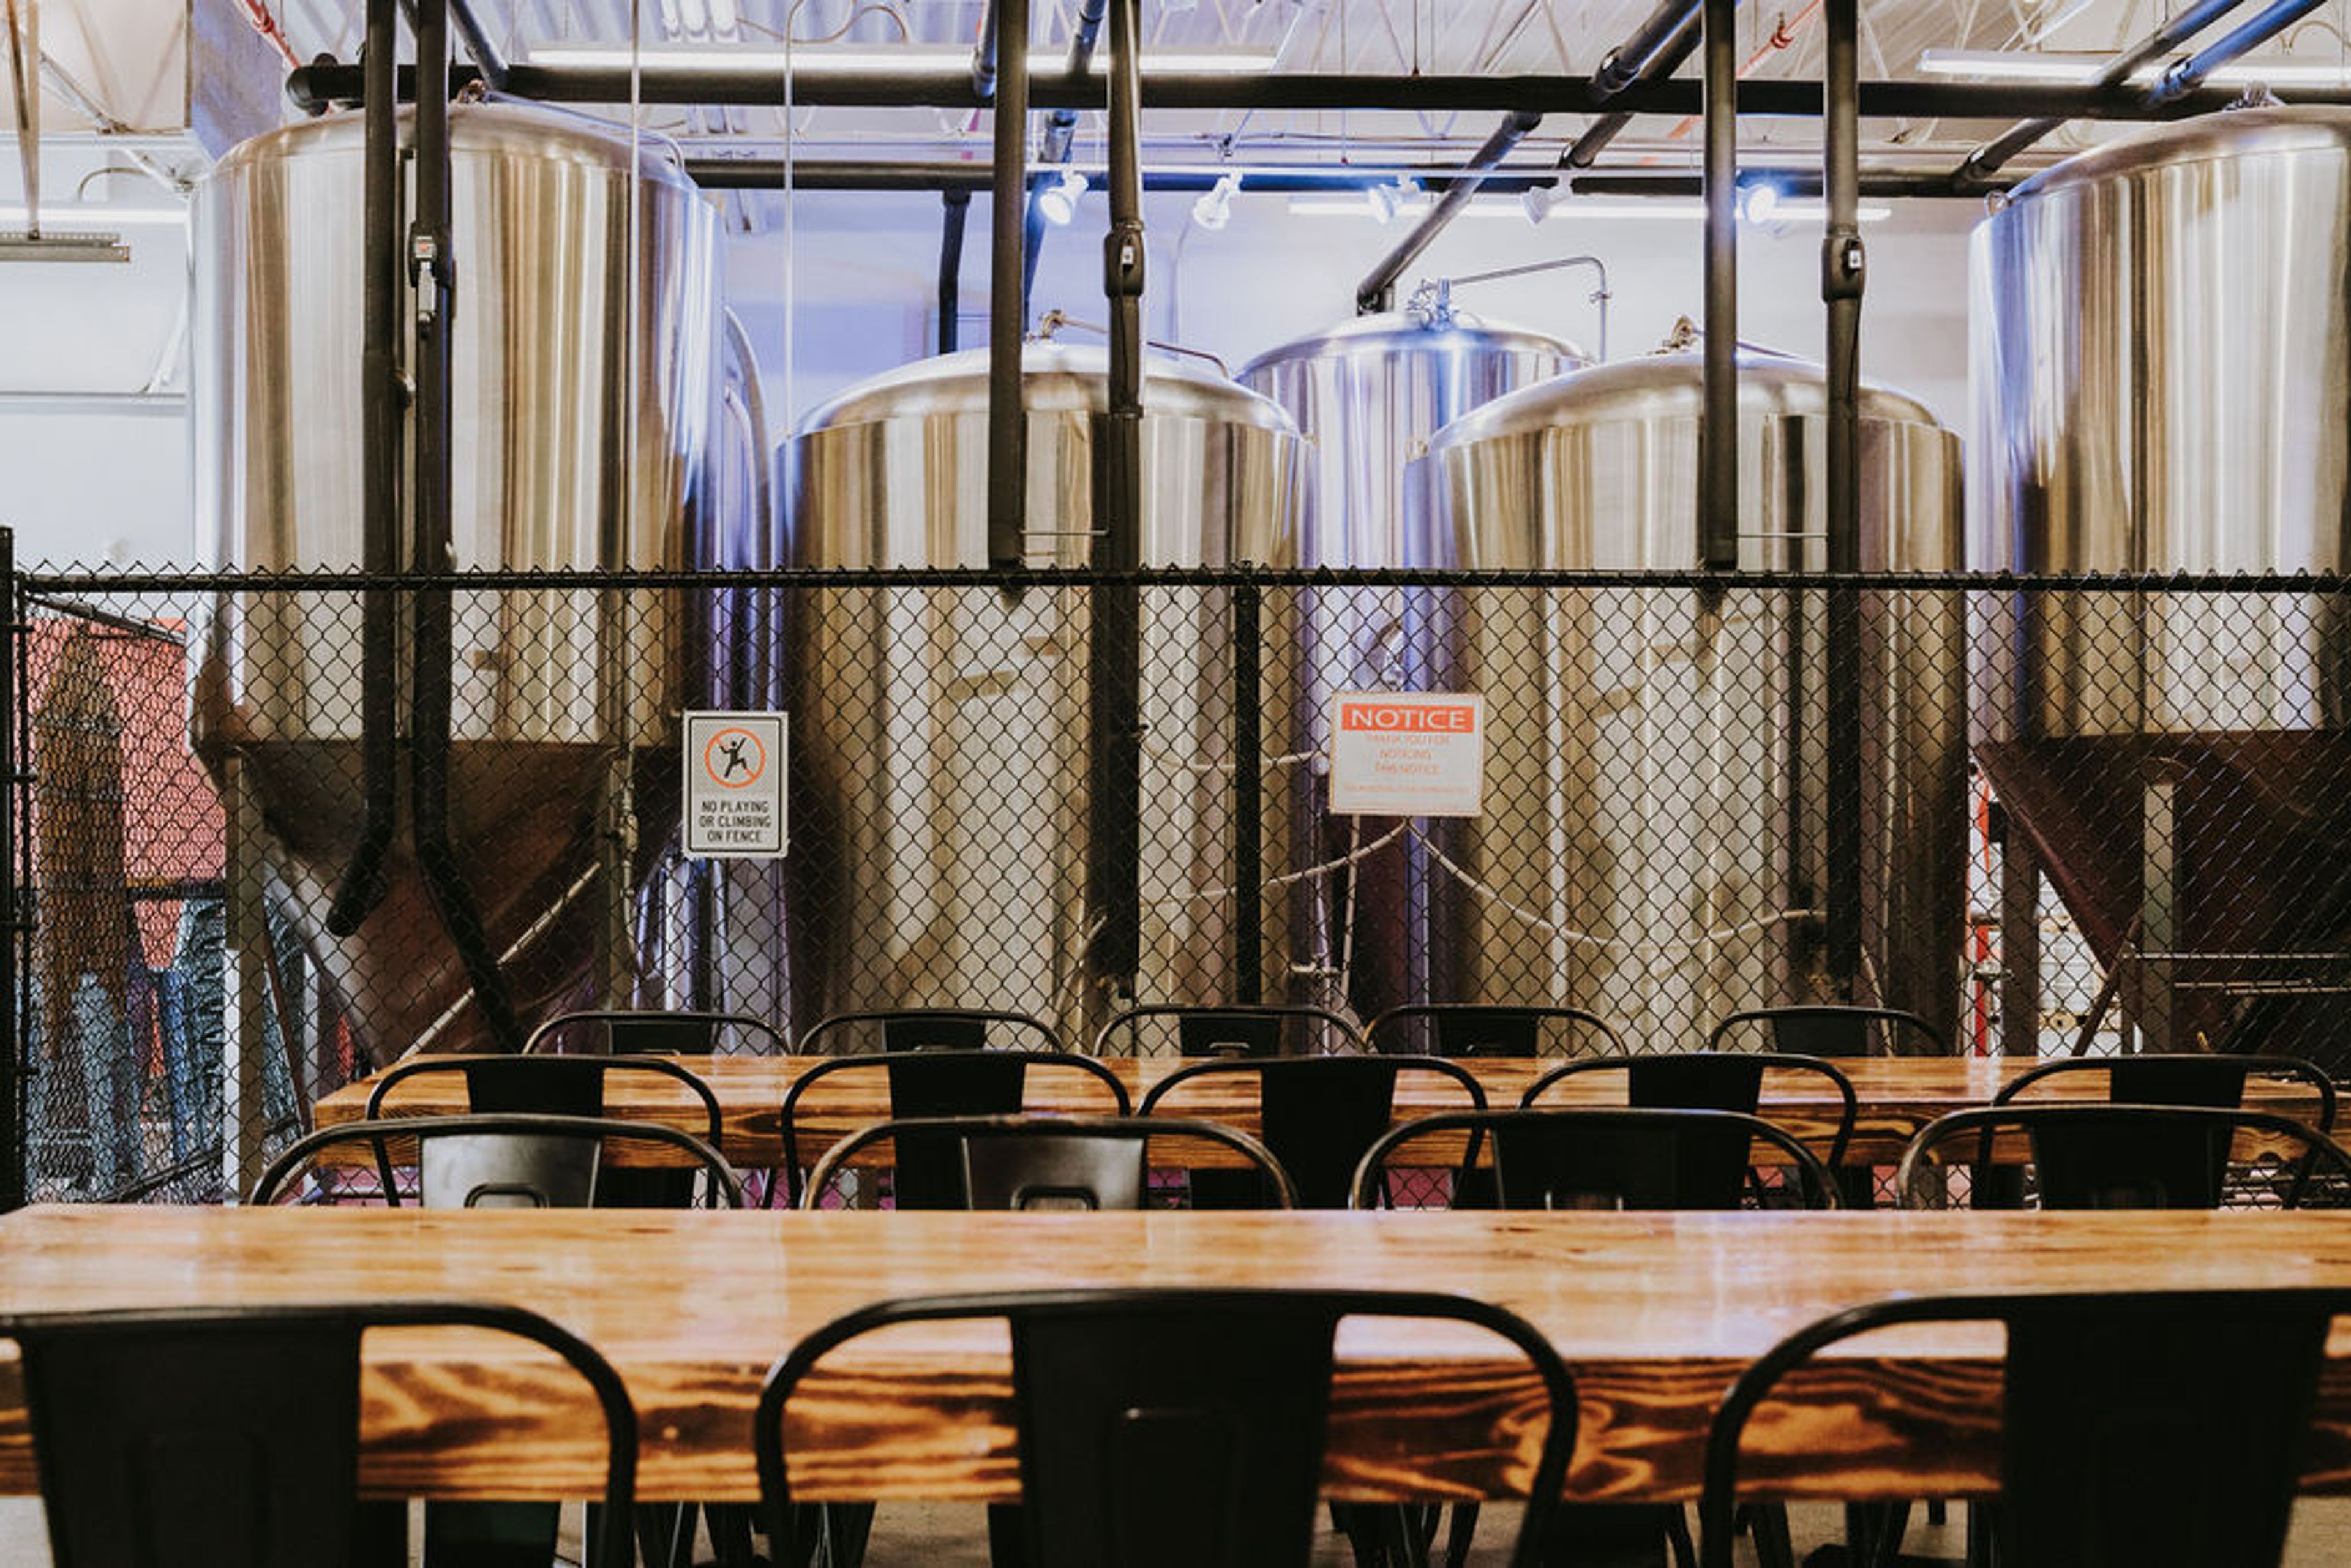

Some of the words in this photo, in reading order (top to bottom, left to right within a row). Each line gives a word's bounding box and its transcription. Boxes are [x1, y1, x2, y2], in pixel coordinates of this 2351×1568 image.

[1352, 708, 1465, 729] NOTICE
[1365, 735, 1400, 743] THANK
[1404, 735, 1427, 744] YOU
[1428, 735, 1450, 744] FOR
[1379, 749, 1431, 759] NOTICING
[1375, 762, 1397, 773] THIS
[1400, 763, 1441, 775] NOTICE
[702, 801, 717, 813] NO
[721, 801, 768, 813] PLAYING
[699, 816, 714, 827] OR
[718, 816, 771, 827] CLIMBING
[707, 830, 722, 842] ON
[726, 830, 762, 843] FENCE
